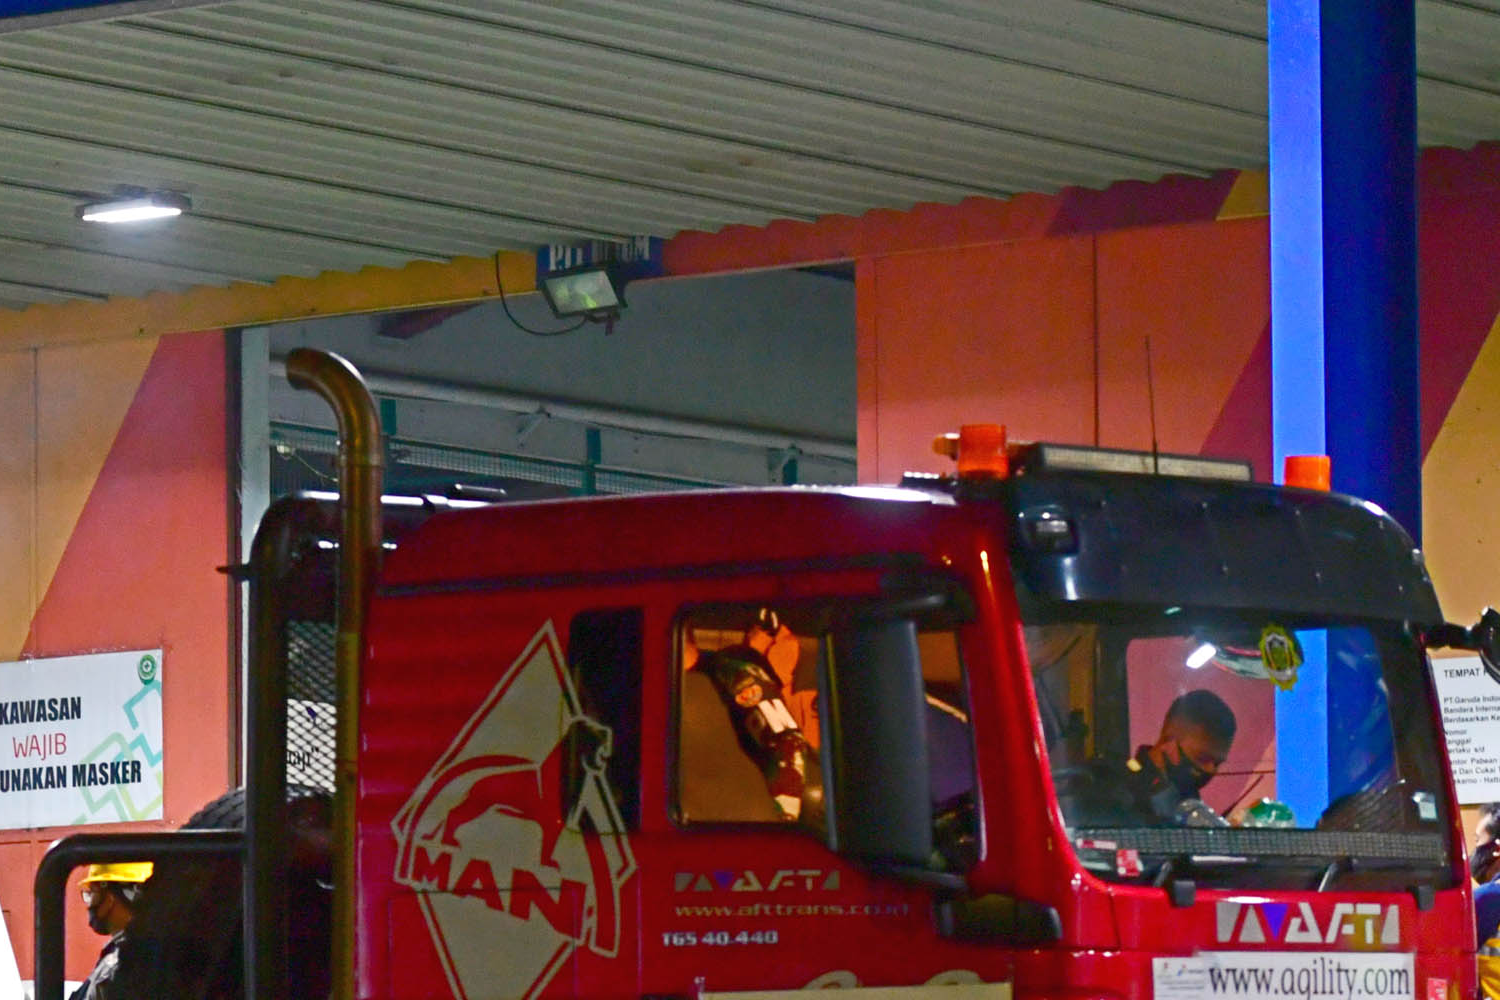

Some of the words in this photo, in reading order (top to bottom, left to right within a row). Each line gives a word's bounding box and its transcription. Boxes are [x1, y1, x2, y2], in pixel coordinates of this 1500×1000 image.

[1444, 668, 1480, 678] TEMPAT
[12, 732, 67, 761] WAJIB
[72, 760, 142, 787] MASKER
[411, 845, 587, 941] MAN
